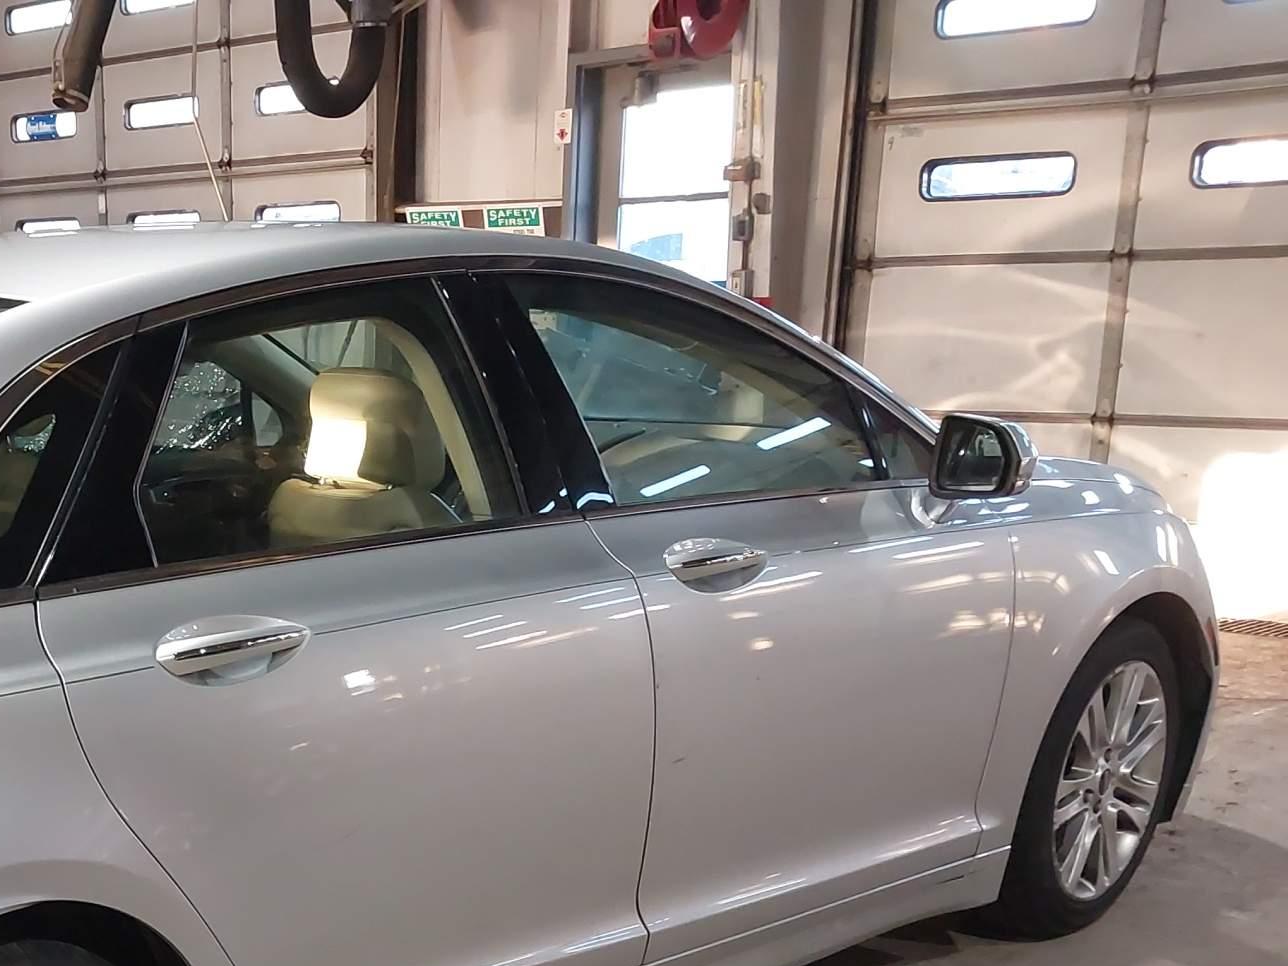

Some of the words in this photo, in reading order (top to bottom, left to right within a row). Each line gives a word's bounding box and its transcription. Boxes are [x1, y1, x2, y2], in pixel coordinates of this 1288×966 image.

[412, 211, 457, 224] SAFETY
[489, 208, 537, 221] SAFETY
[497, 217, 531, 226] FIRST
